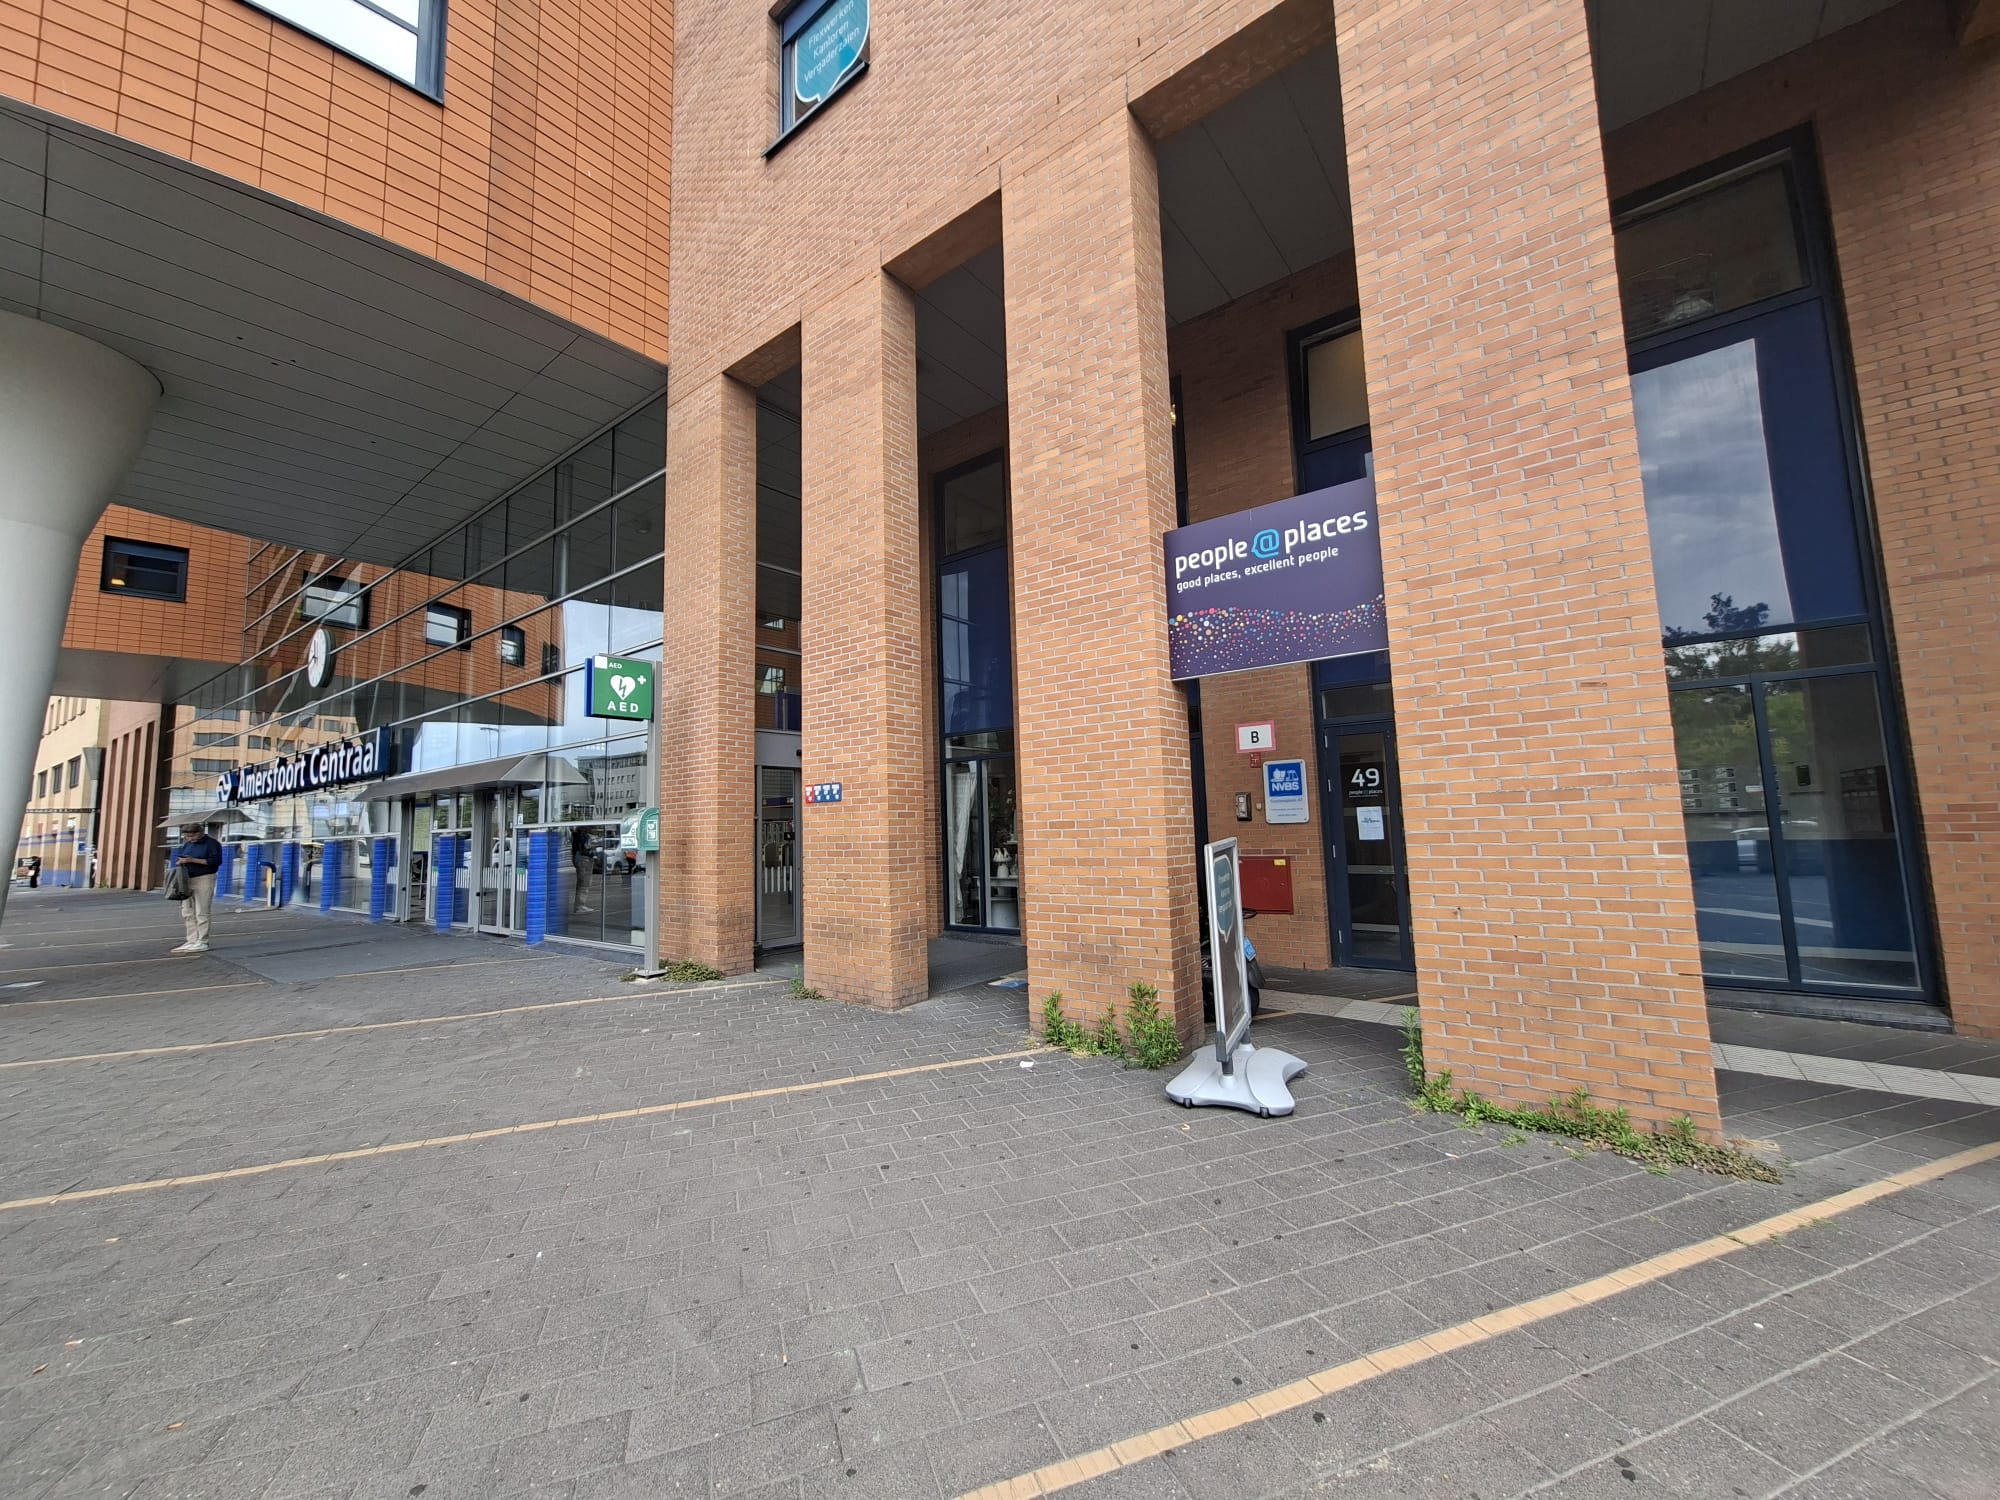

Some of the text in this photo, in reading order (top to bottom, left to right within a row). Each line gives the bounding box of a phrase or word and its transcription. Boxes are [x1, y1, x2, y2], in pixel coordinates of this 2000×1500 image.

[808, 0, 854, 48] Flexwerken
[813, 20, 849, 59] Kantoren
[803, 27, 860, 83] Vergaderzalen
[1176, 546, 1339, 593] good places, excellent people
[607, 700, 639, 713] AED
[1250, 731, 1260, 744] B
[237, 726, 380, 800] Amersfoort Centraal
[1350, 767, 1380, 788] 49
[1271, 781, 1300, 792] NVBS
